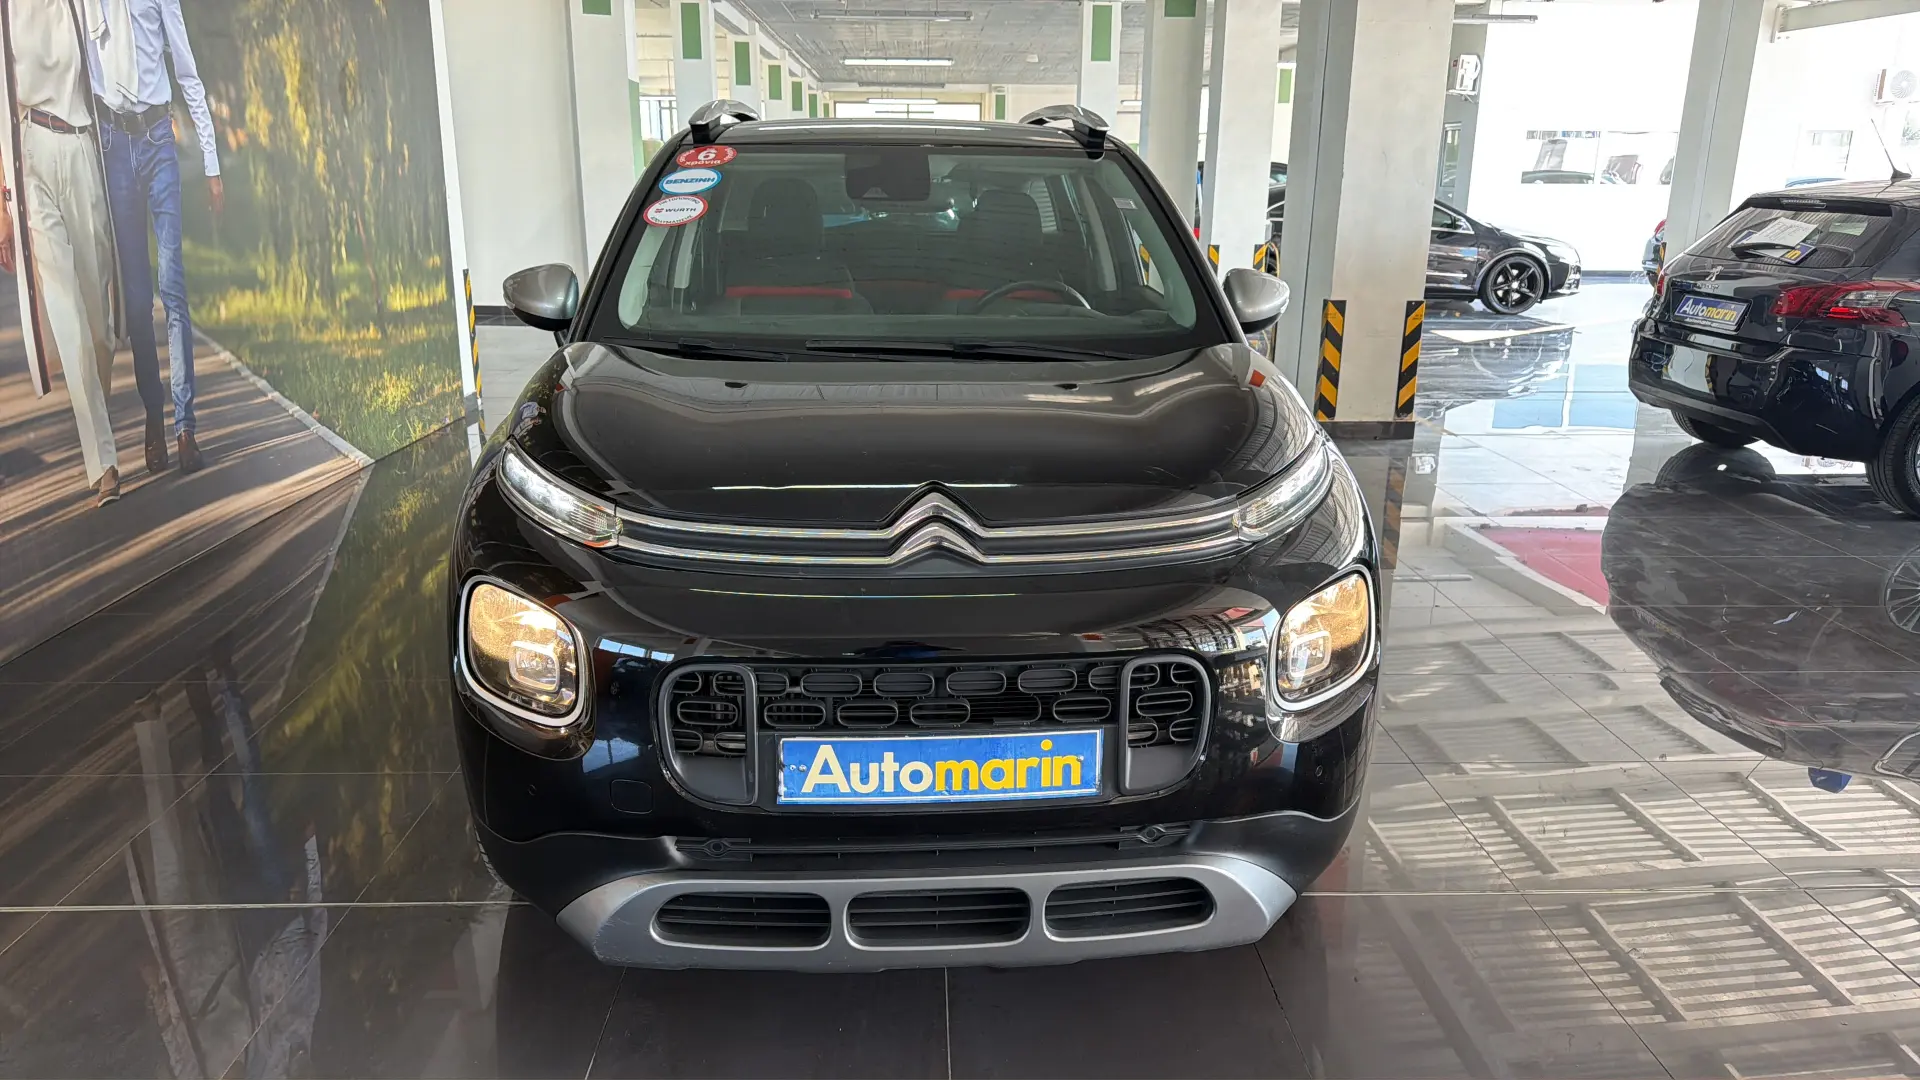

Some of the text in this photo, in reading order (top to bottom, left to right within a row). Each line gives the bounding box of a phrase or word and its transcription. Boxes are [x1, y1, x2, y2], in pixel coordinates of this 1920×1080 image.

[697, 149, 717, 161] 6
[1680, 299, 1737, 321] Automarin
[801, 739, 1081, 793] Automarin
